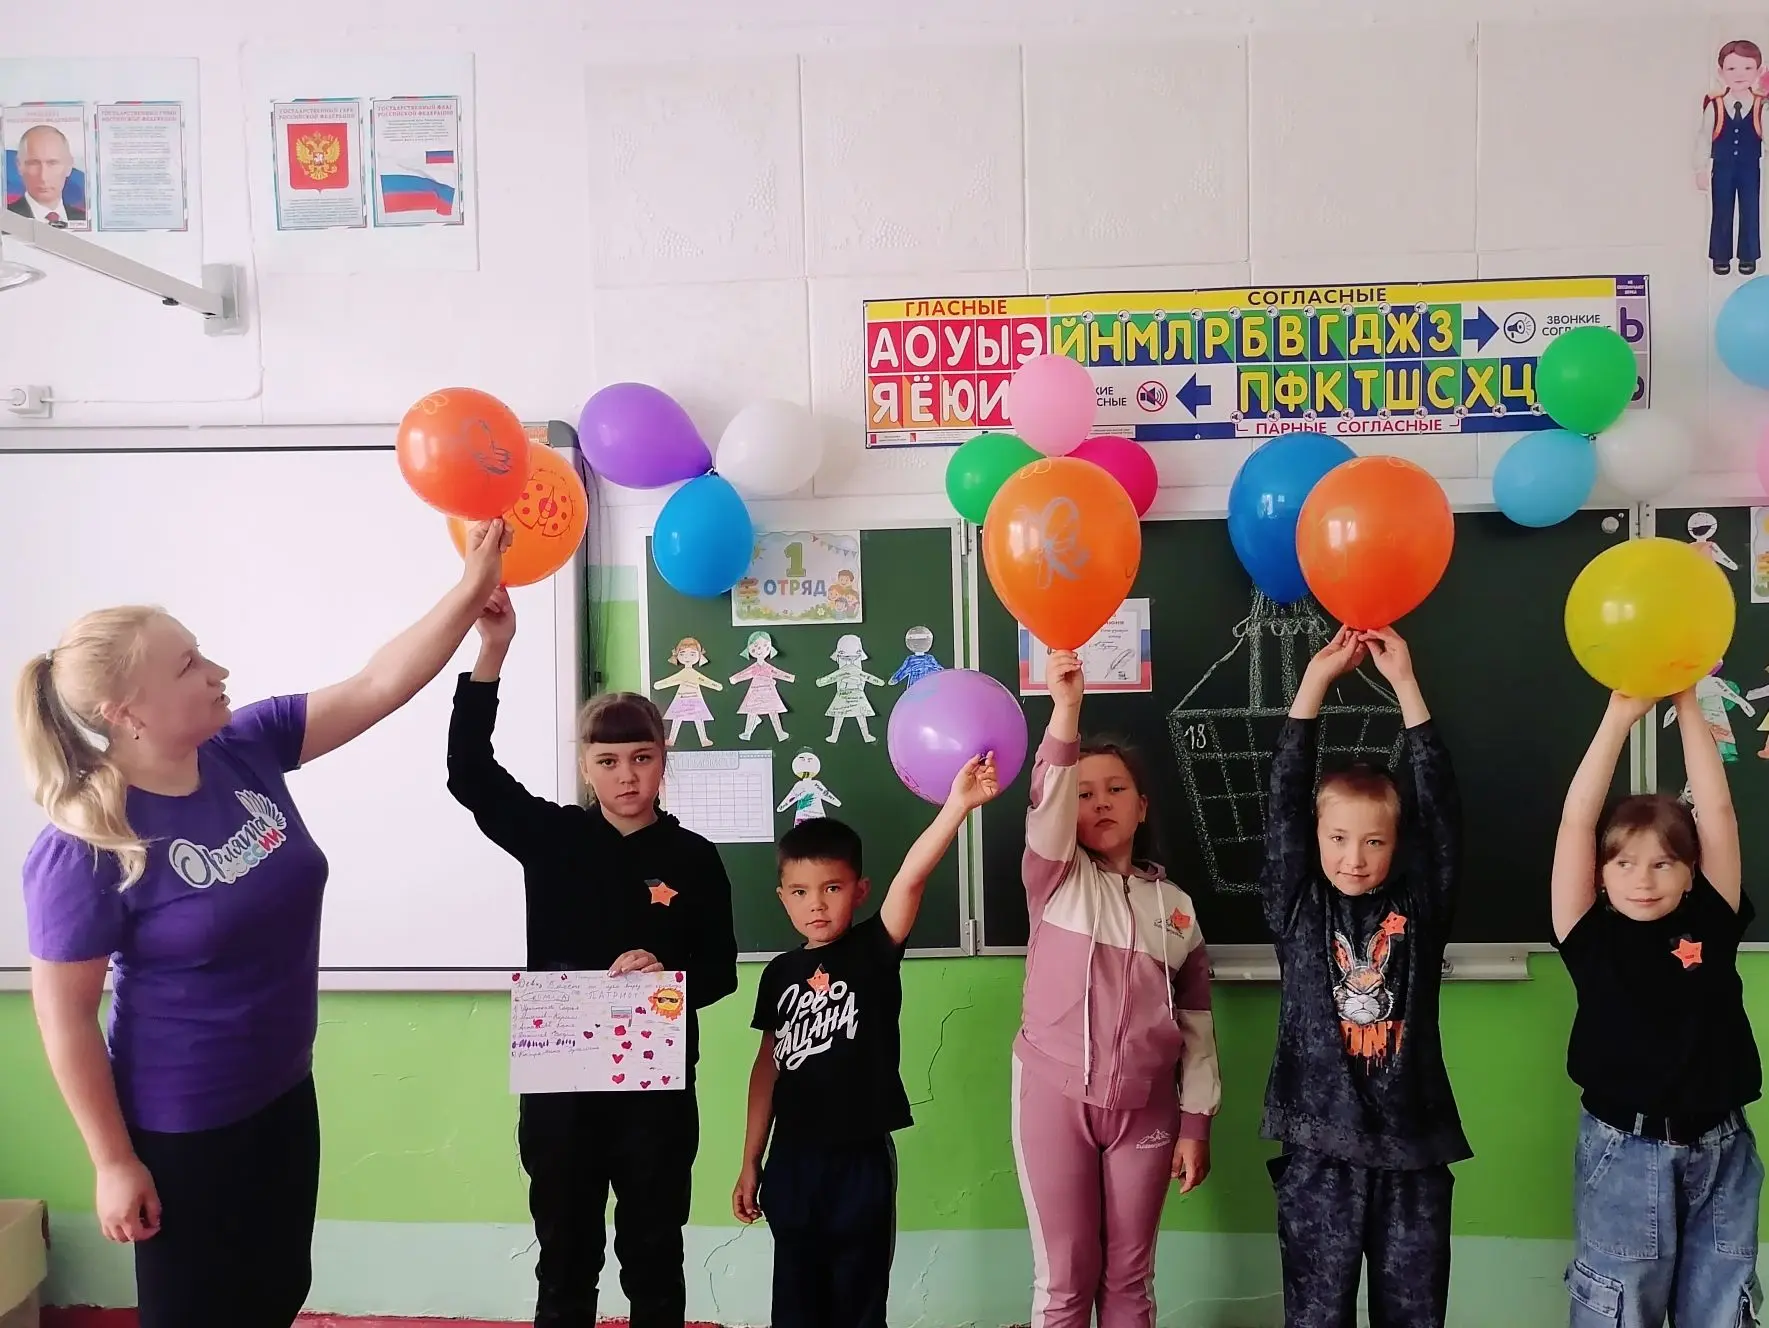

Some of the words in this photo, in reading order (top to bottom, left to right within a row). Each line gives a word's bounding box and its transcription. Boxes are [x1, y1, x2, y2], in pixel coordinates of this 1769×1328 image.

[1248, 288, 1387, 306] СОГЛАСНЫЕ
[905, 299, 1007, 317] ГЛАСНЫЕ
[1547, 314, 1601, 326] ЗВОНКИЕ
[1256, 421, 1327, 436] ПАРНЫЕ
[1337, 418, 1442, 434] СОГЛАСНЫЕ
[784, 542, 806, 577] 1
[763, 578, 827, 597] ОТРЯД
